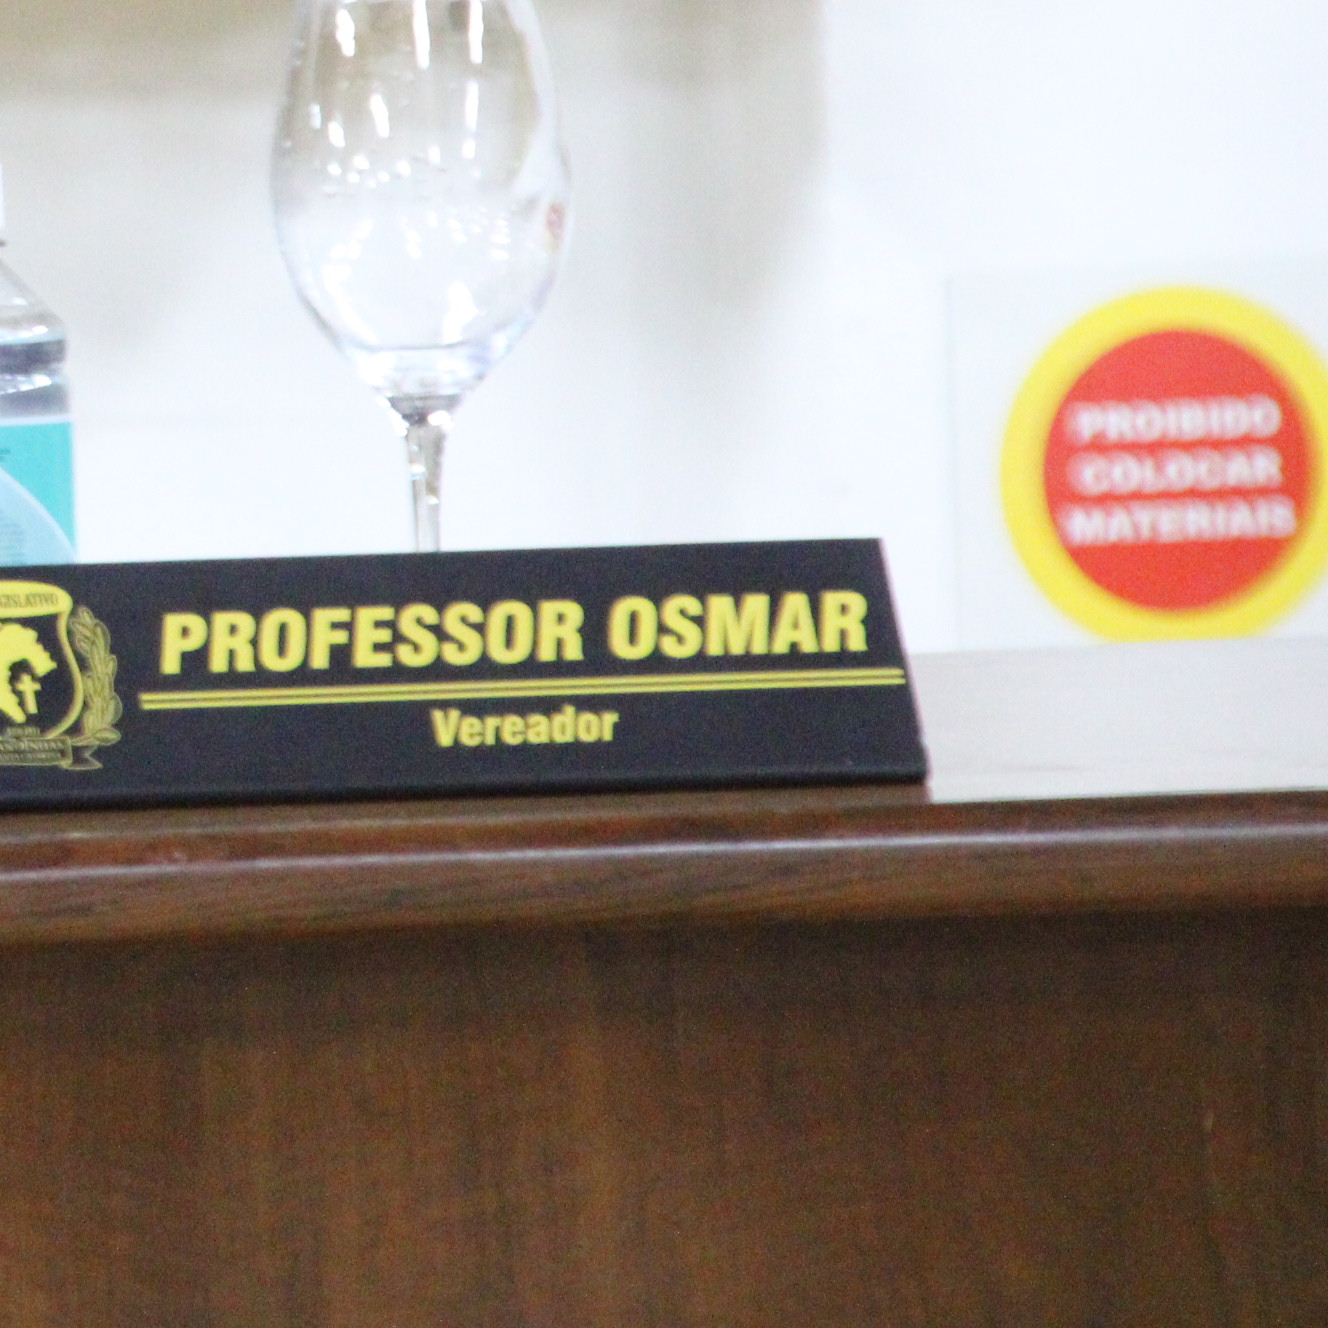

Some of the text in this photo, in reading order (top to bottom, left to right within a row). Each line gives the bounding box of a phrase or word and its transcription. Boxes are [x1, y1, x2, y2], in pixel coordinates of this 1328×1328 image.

[1066, 395, 1282, 445] PROIBIDO
[1068, 445, 1283, 496] COLOCAR
[1059, 494, 1297, 546] MATERIAIS
[159, 590, 869, 675] PROFESSOR OSMAR
[431, 703, 619, 748] Vereador
